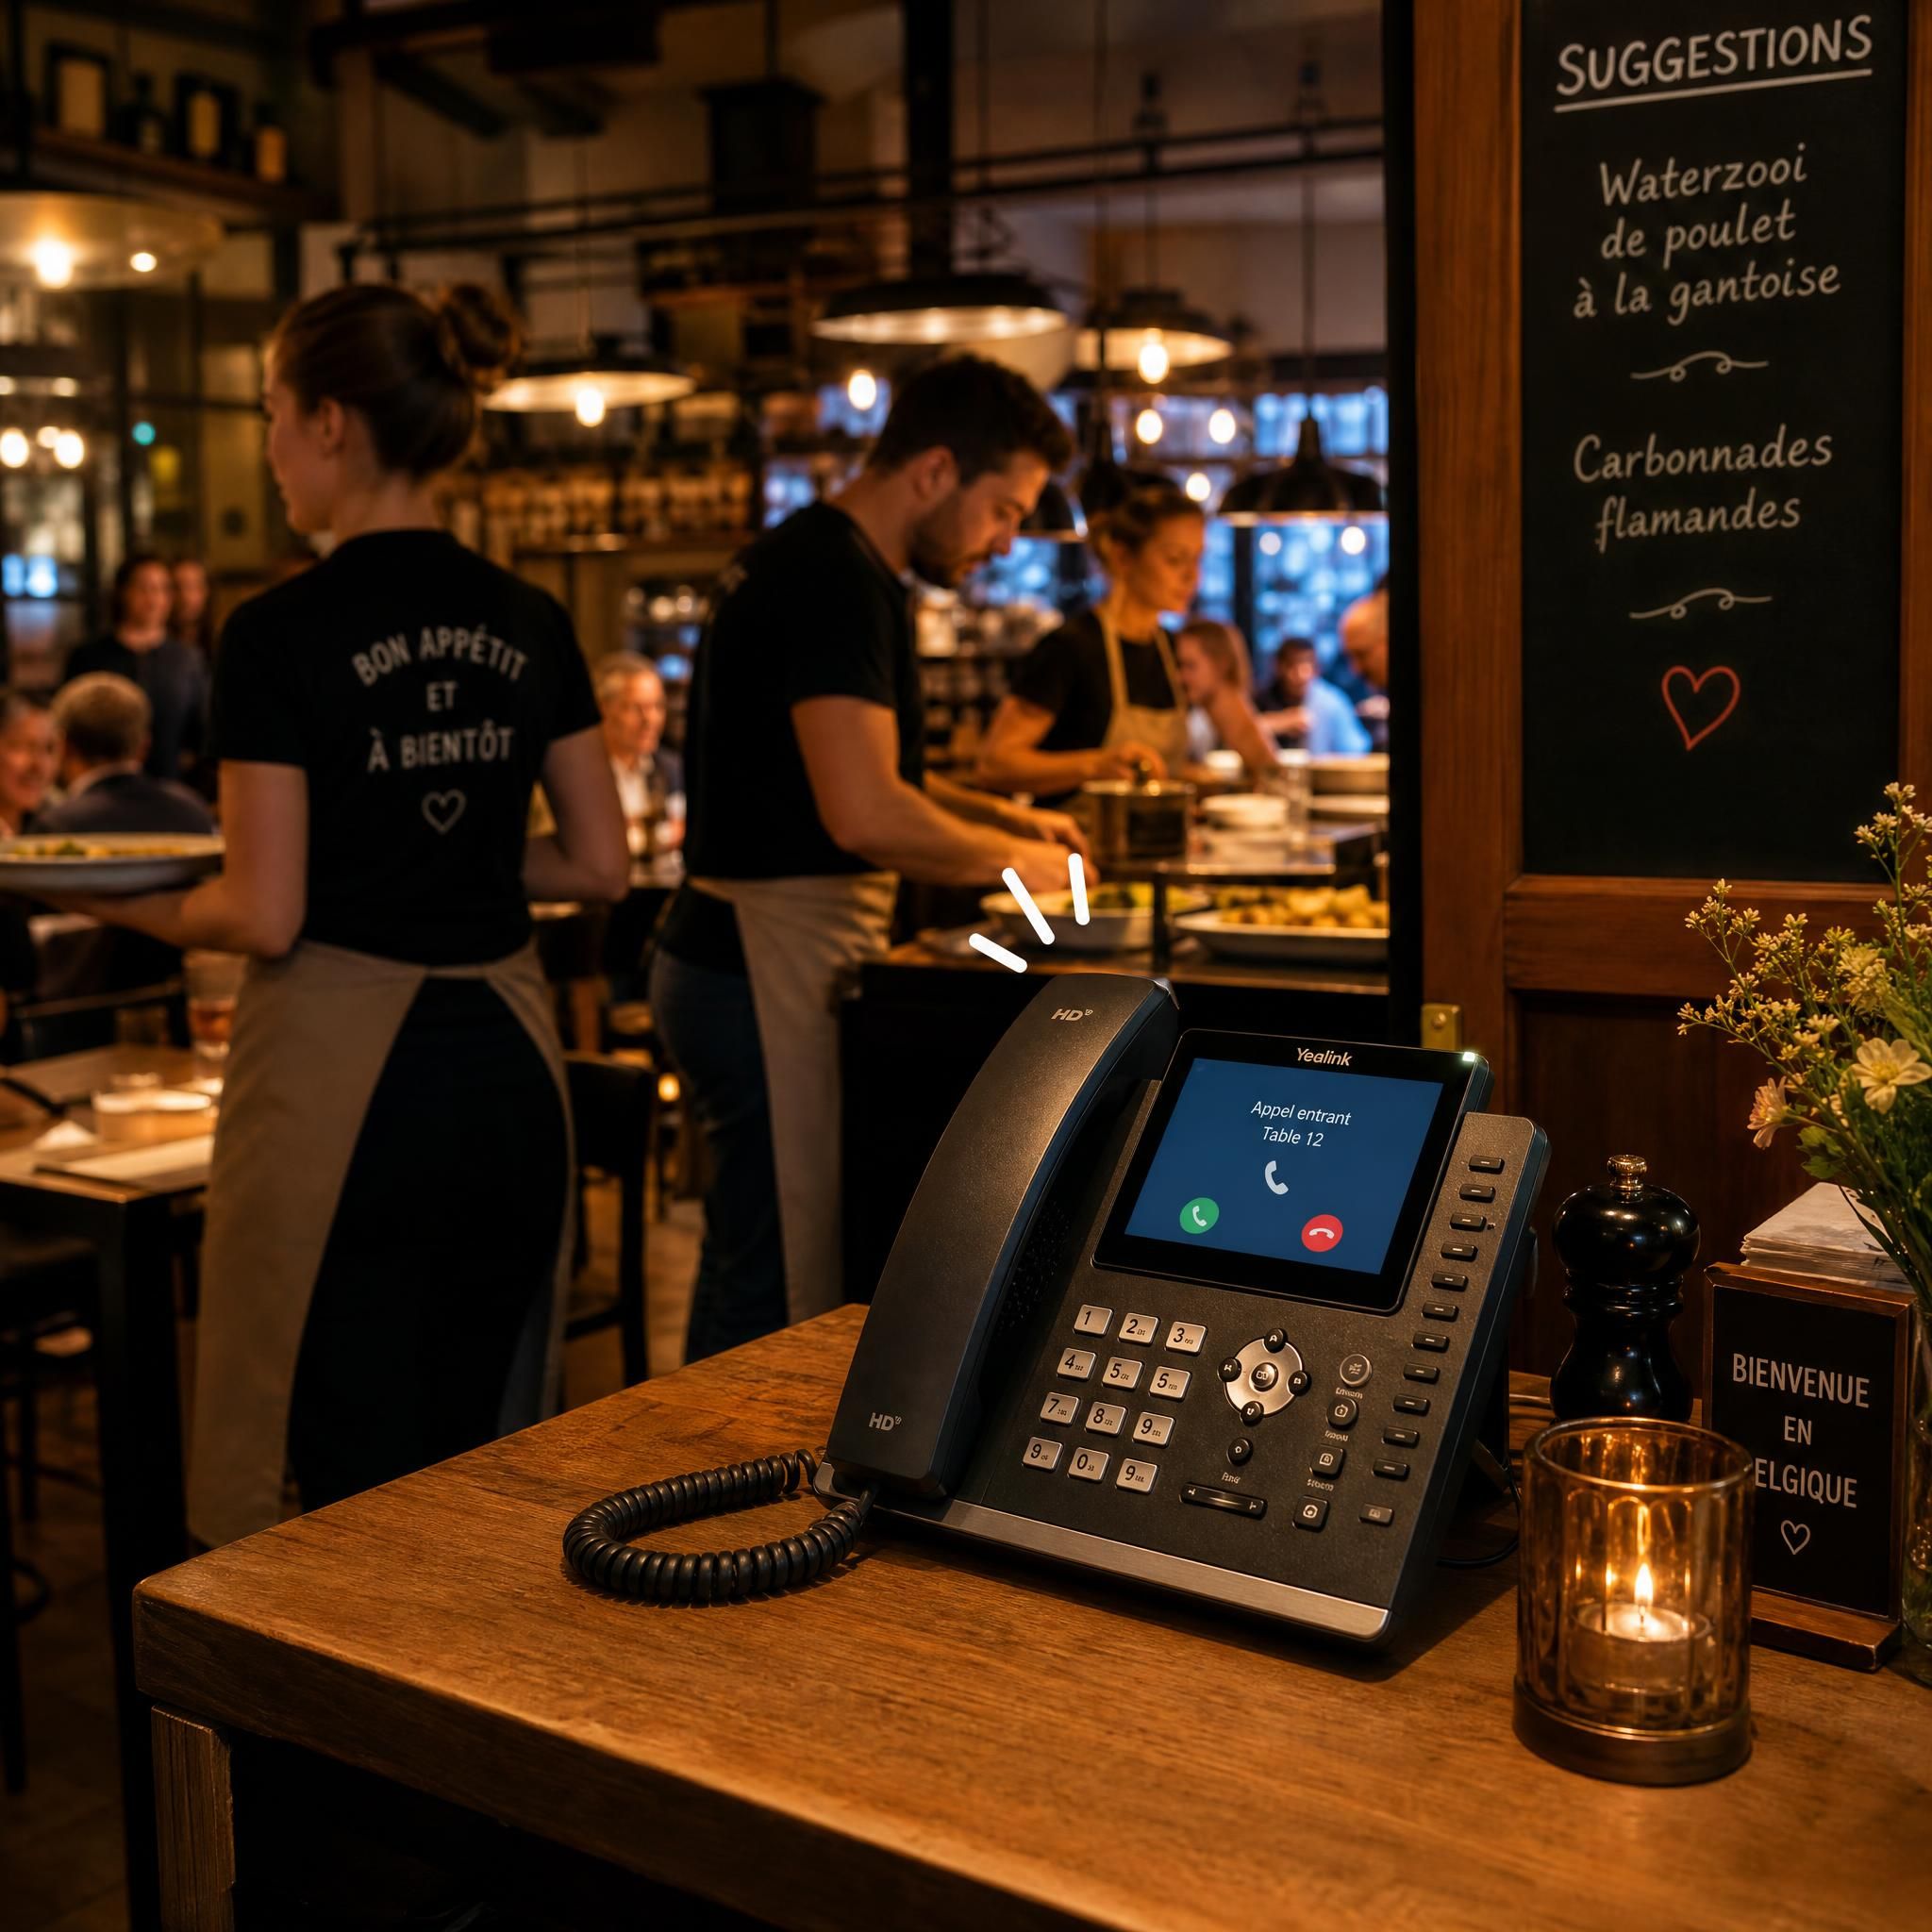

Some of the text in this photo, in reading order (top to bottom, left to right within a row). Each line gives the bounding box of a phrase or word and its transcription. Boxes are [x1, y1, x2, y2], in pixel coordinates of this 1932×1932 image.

[1557, 14, 1873, 95] SUGGESTIONS
[1600, 142, 1807, 207] Waterzooi
[1601, 199, 1795, 270] de poulet
[1574, 258, 1840, 326] à la gantoise
[1574, 424, 1833, 483] Carbonnades
[1595, 487, 1801, 554] flamandes
[352, 623, 528, 687] BON APPÉTIT
[426, 680, 458, 711] ET
[368, 719, 514, 773] À BIENTÔT
[1250, 1100, 1352, 1126] Appel entrant
[1262, 1125, 1324, 1147] Table 12
[1084, 1310, 1092, 1325] 1
[1126, 1318, 1139, 1334] 2
[1173, 1327, 1185, 1343] 3
[1064, 1354, 1075, 1369] 4
[1109, 1363, 1123, 1379] 5
[1732, 1353, 1870, 1408] BIENVENUE
[1047, 1398, 1060, 1414] 7
[1092, 1407, 1105, 1424] 8
[1141, 1418, 1153, 1434] 9
[1784, 1415, 1812, 1446] EN
[1030, 1443, 1042, 1459] 9
[1076, 1454, 1089, 1470] 0
[1124, 1465, 1136, 1481] 9
[1753, 1457, 1857, 1508] ELGIQUE
